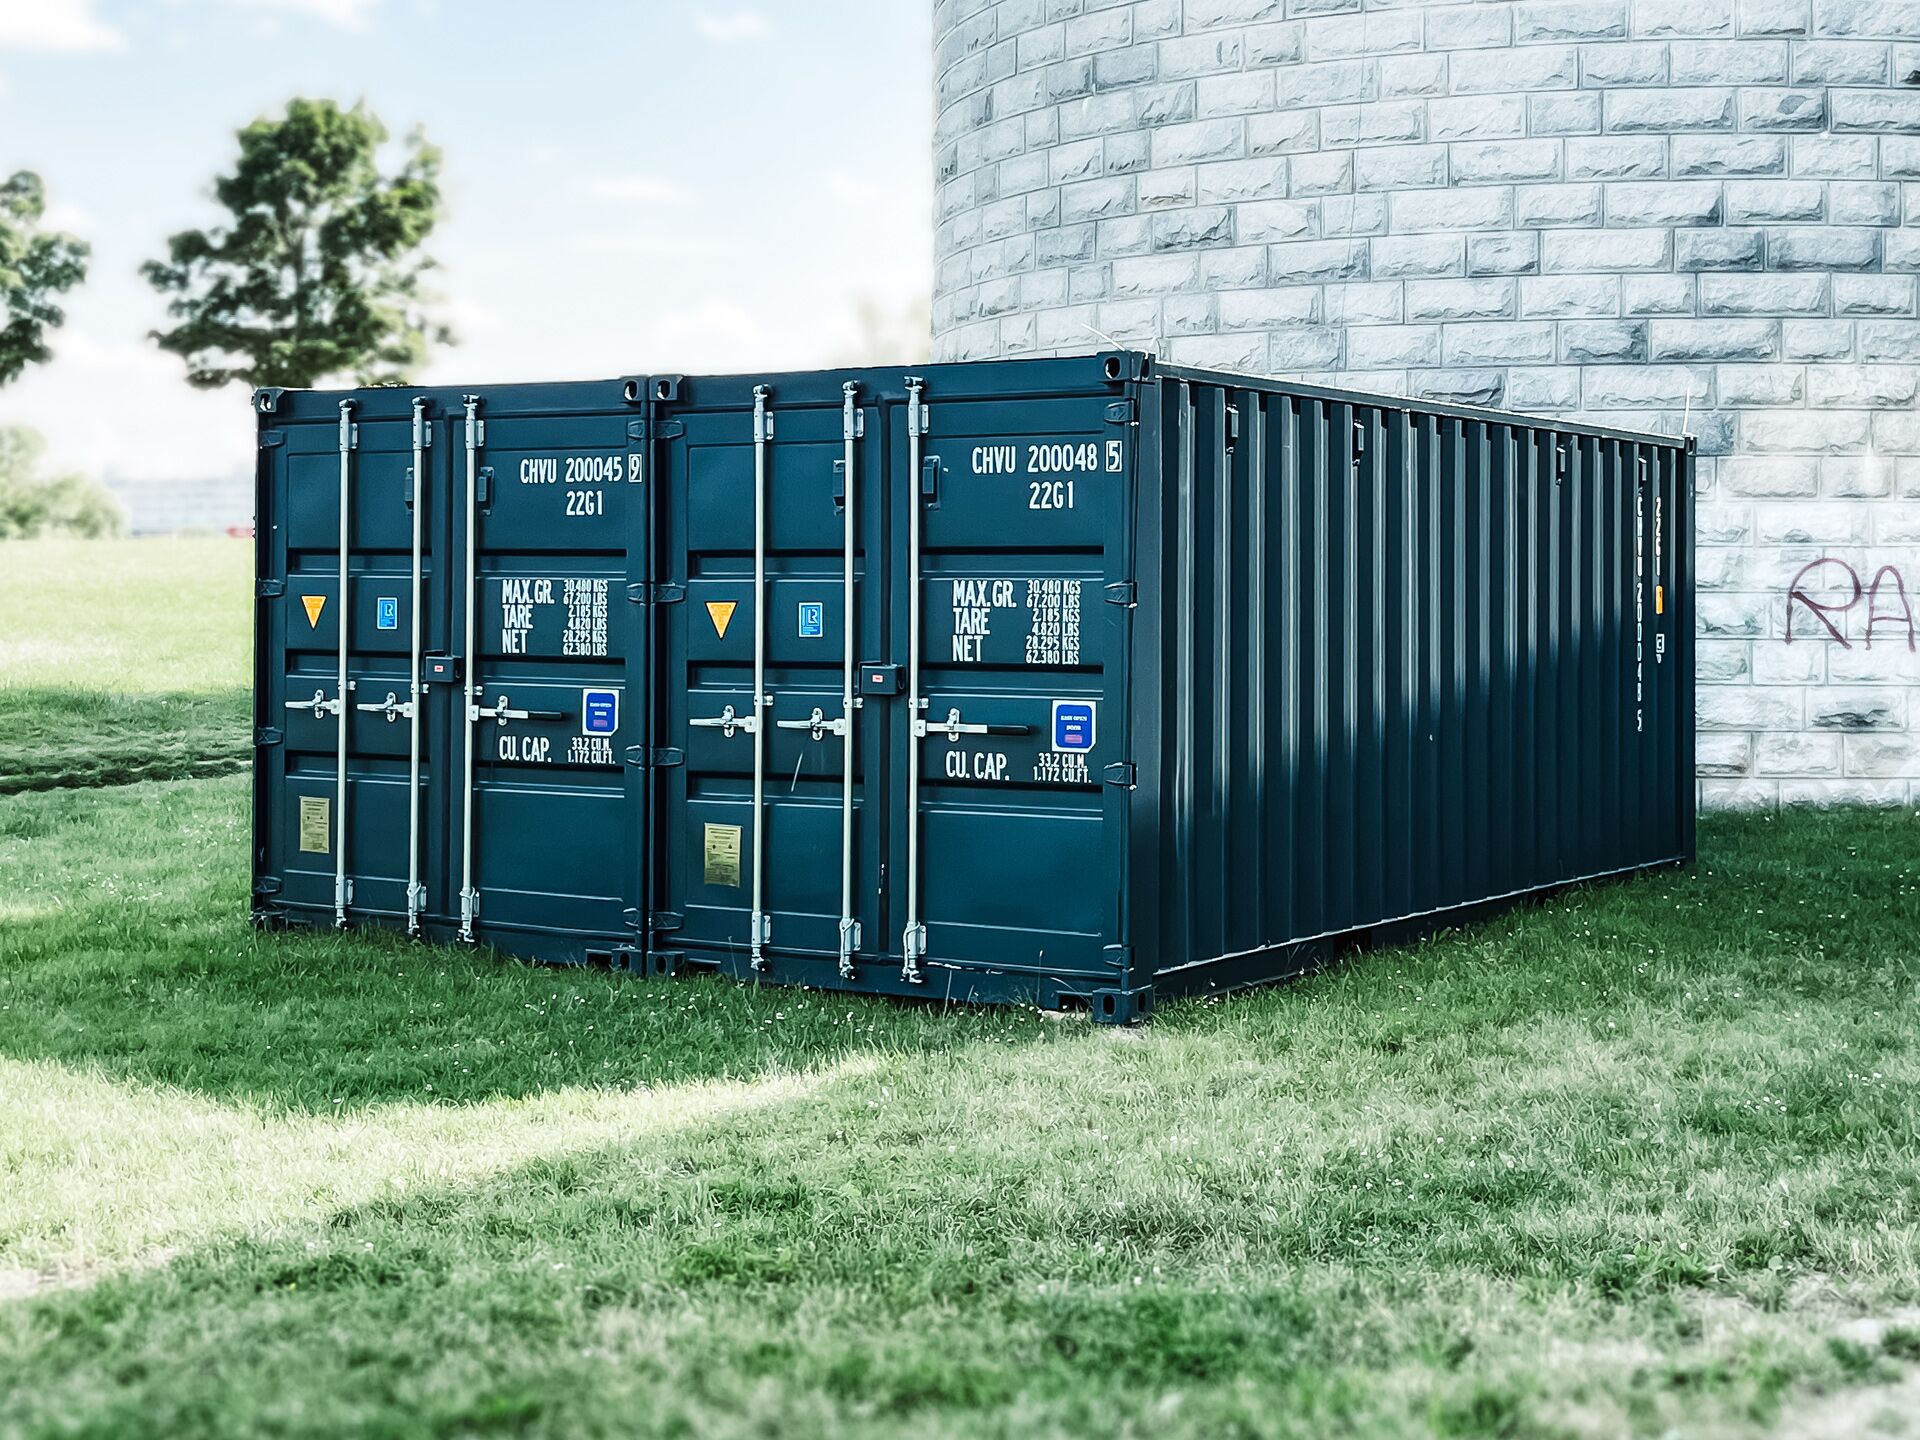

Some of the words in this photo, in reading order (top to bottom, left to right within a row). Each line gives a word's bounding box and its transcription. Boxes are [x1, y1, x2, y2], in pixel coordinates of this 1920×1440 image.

[972, 446, 1016, 474] CHVU
[1027, 443, 1098, 473] 200048
[1107, 442, 1121, 471] 5
[520, 459, 557, 484] CHVU
[565, 456, 623, 482] 200045
[630, 455, 641, 481] 9
[1029, 481, 1074, 509] 22G1
[566, 490, 603, 516] 22G1
[593, 579, 609, 592] KGS
[1063, 580, 1081, 595] KGS
[592, 592, 608, 605] LBS
[1063, 594, 1080, 608] LBS
[1785, 558, 1916, 653] RA
[502, 604, 534, 629] TARE
[592, 605, 608, 618] KGS
[1062, 608, 1080, 622] KGS
[592, 618, 607, 630] LBS
[953, 607, 991, 634] TARE
[592, 630, 607, 643] KGS
[1062, 622, 1079, 636] LBS
[502, 629, 528, 654] NET
[592, 642, 607, 656] LBS
[952, 635, 983, 661] NET
[1062, 636, 1080, 650] KGS
[1062, 650, 1079, 665] LBS
[499, 736, 520, 761] CU.
[522, 737, 552, 762] CAP.
[945, 750, 970, 778] CU.
[974, 752, 1010, 781] CAP.
